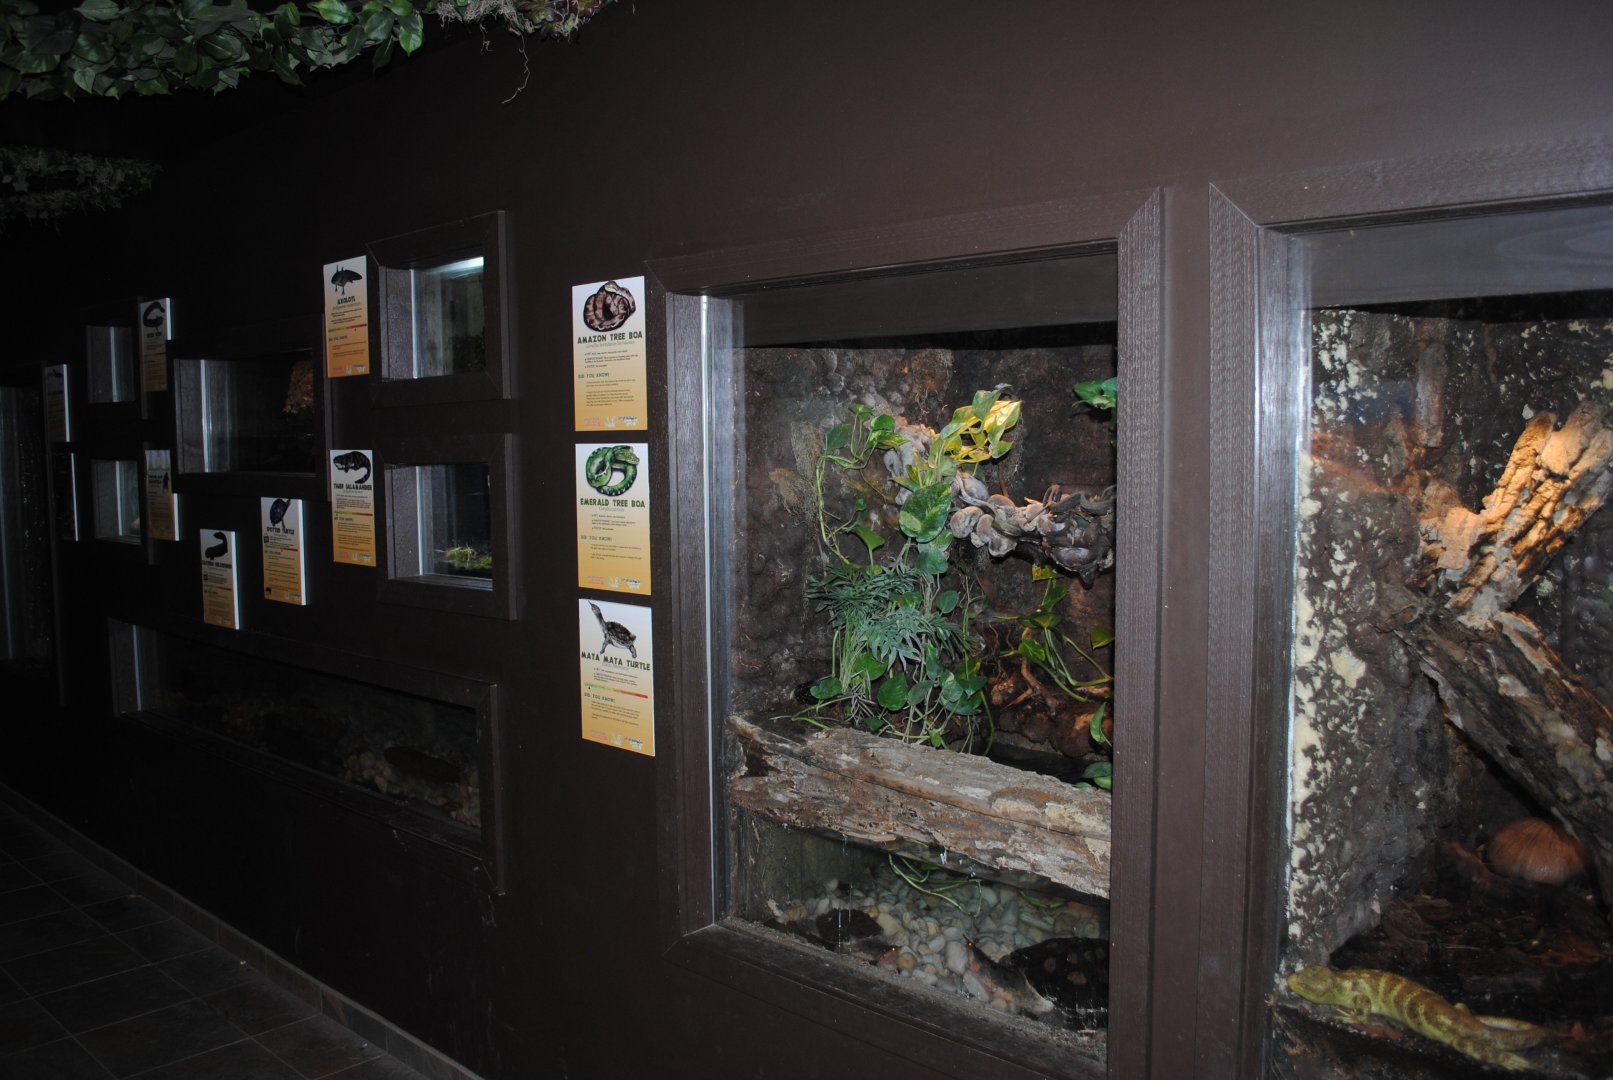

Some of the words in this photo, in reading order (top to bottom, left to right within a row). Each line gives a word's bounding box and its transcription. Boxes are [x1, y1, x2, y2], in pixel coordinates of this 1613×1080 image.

[577, 334, 607, 344] AMAZON
[610, 332, 625, 341] TREE
[628, 331, 643, 339] BOA
[580, 498, 609, 507] EMERALD
[613, 499, 628, 507] TREE
[631, 500, 646, 508] BOA
[581, 651, 600, 661] MATA
[626, 660, 651, 671] TURTLE
